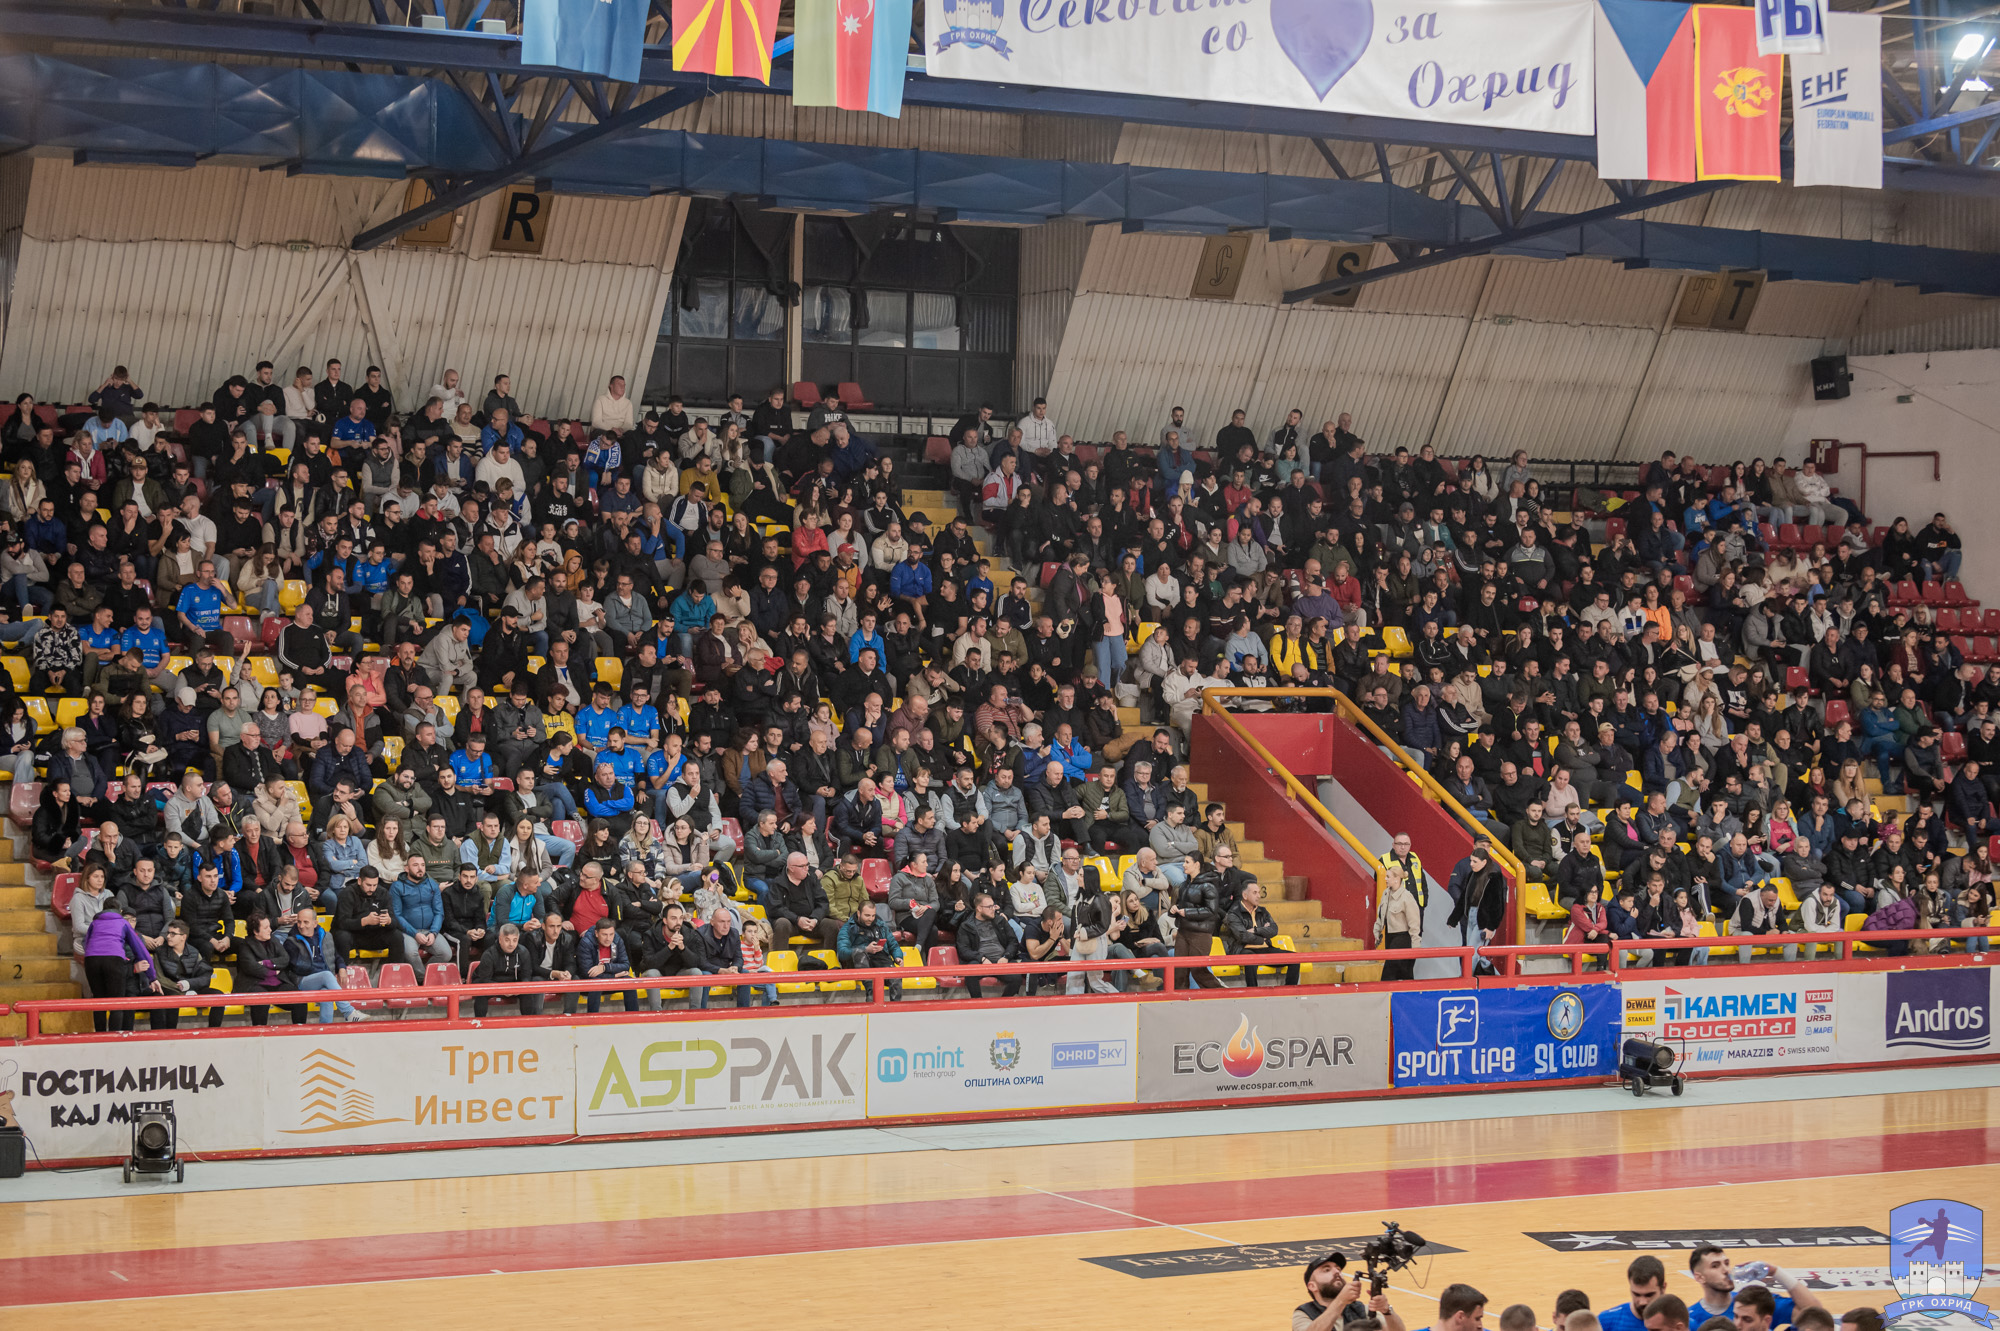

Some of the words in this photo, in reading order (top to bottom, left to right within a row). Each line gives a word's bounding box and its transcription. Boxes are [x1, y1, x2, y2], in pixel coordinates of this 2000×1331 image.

[950, 31, 966, 41] ГРК
[969, 32, 997, 46] ОХРИД
[1201, 20, 1253, 55] со
[1386, 12, 1443, 44] за
[1407, 60, 1578, 111] Охрид
[1801, 67, 1849, 101] EHF
[502, 192, 540, 242] R
[1331, 251, 1360, 296] S
[1728, 279, 1754, 321] T
[1260, 886, 1268, 899] 3
[1303, 925, 1311, 938] 2
[13, 964, 23, 979] 2
[1685, 993, 1797, 1019] KARMEN
[1806, 991, 1833, 1002] VELUX
[1668, 1020, 1791, 1038] baucentar
[1895, 1000, 1984, 1034] Andros
[1813, 1026, 1833, 1035] MAPEI
[912, 1046, 965, 1070] mint
[1055, 1047, 1097, 1063] OHRID
[1100, 1046, 1123, 1061] SKY
[1535, 1043, 1558, 1075] SL
[1562, 1043, 1598, 1070] CLUB
[1727, 1048, 1766, 1059] MARAZZI
[1787, 1047, 1806, 1055] SWISS
[1807, 1045, 1830, 1054] KRONO
[442, 1045, 540, 1083] Трпе
[588, 1032, 857, 1110] ASPPAK
[913, 1070, 937, 1079] fintech
[938, 1070, 957, 1080] group
[1397, 1048, 1463, 1079] SPORT
[22, 1063, 225, 1097] ГОСТИЛНИЦА
[963, 1077, 1011, 1088] ОПШТИНА
[1013, 1074, 1044, 1087] ОХРИД
[1216, 1078, 1314, 1093] www.ecospar.com.mk
[50, 1103, 100, 1129] КАЈ
[415, 1094, 563, 1125] Инвест
[1631, 1236, 1891, 1248] STELLAR
